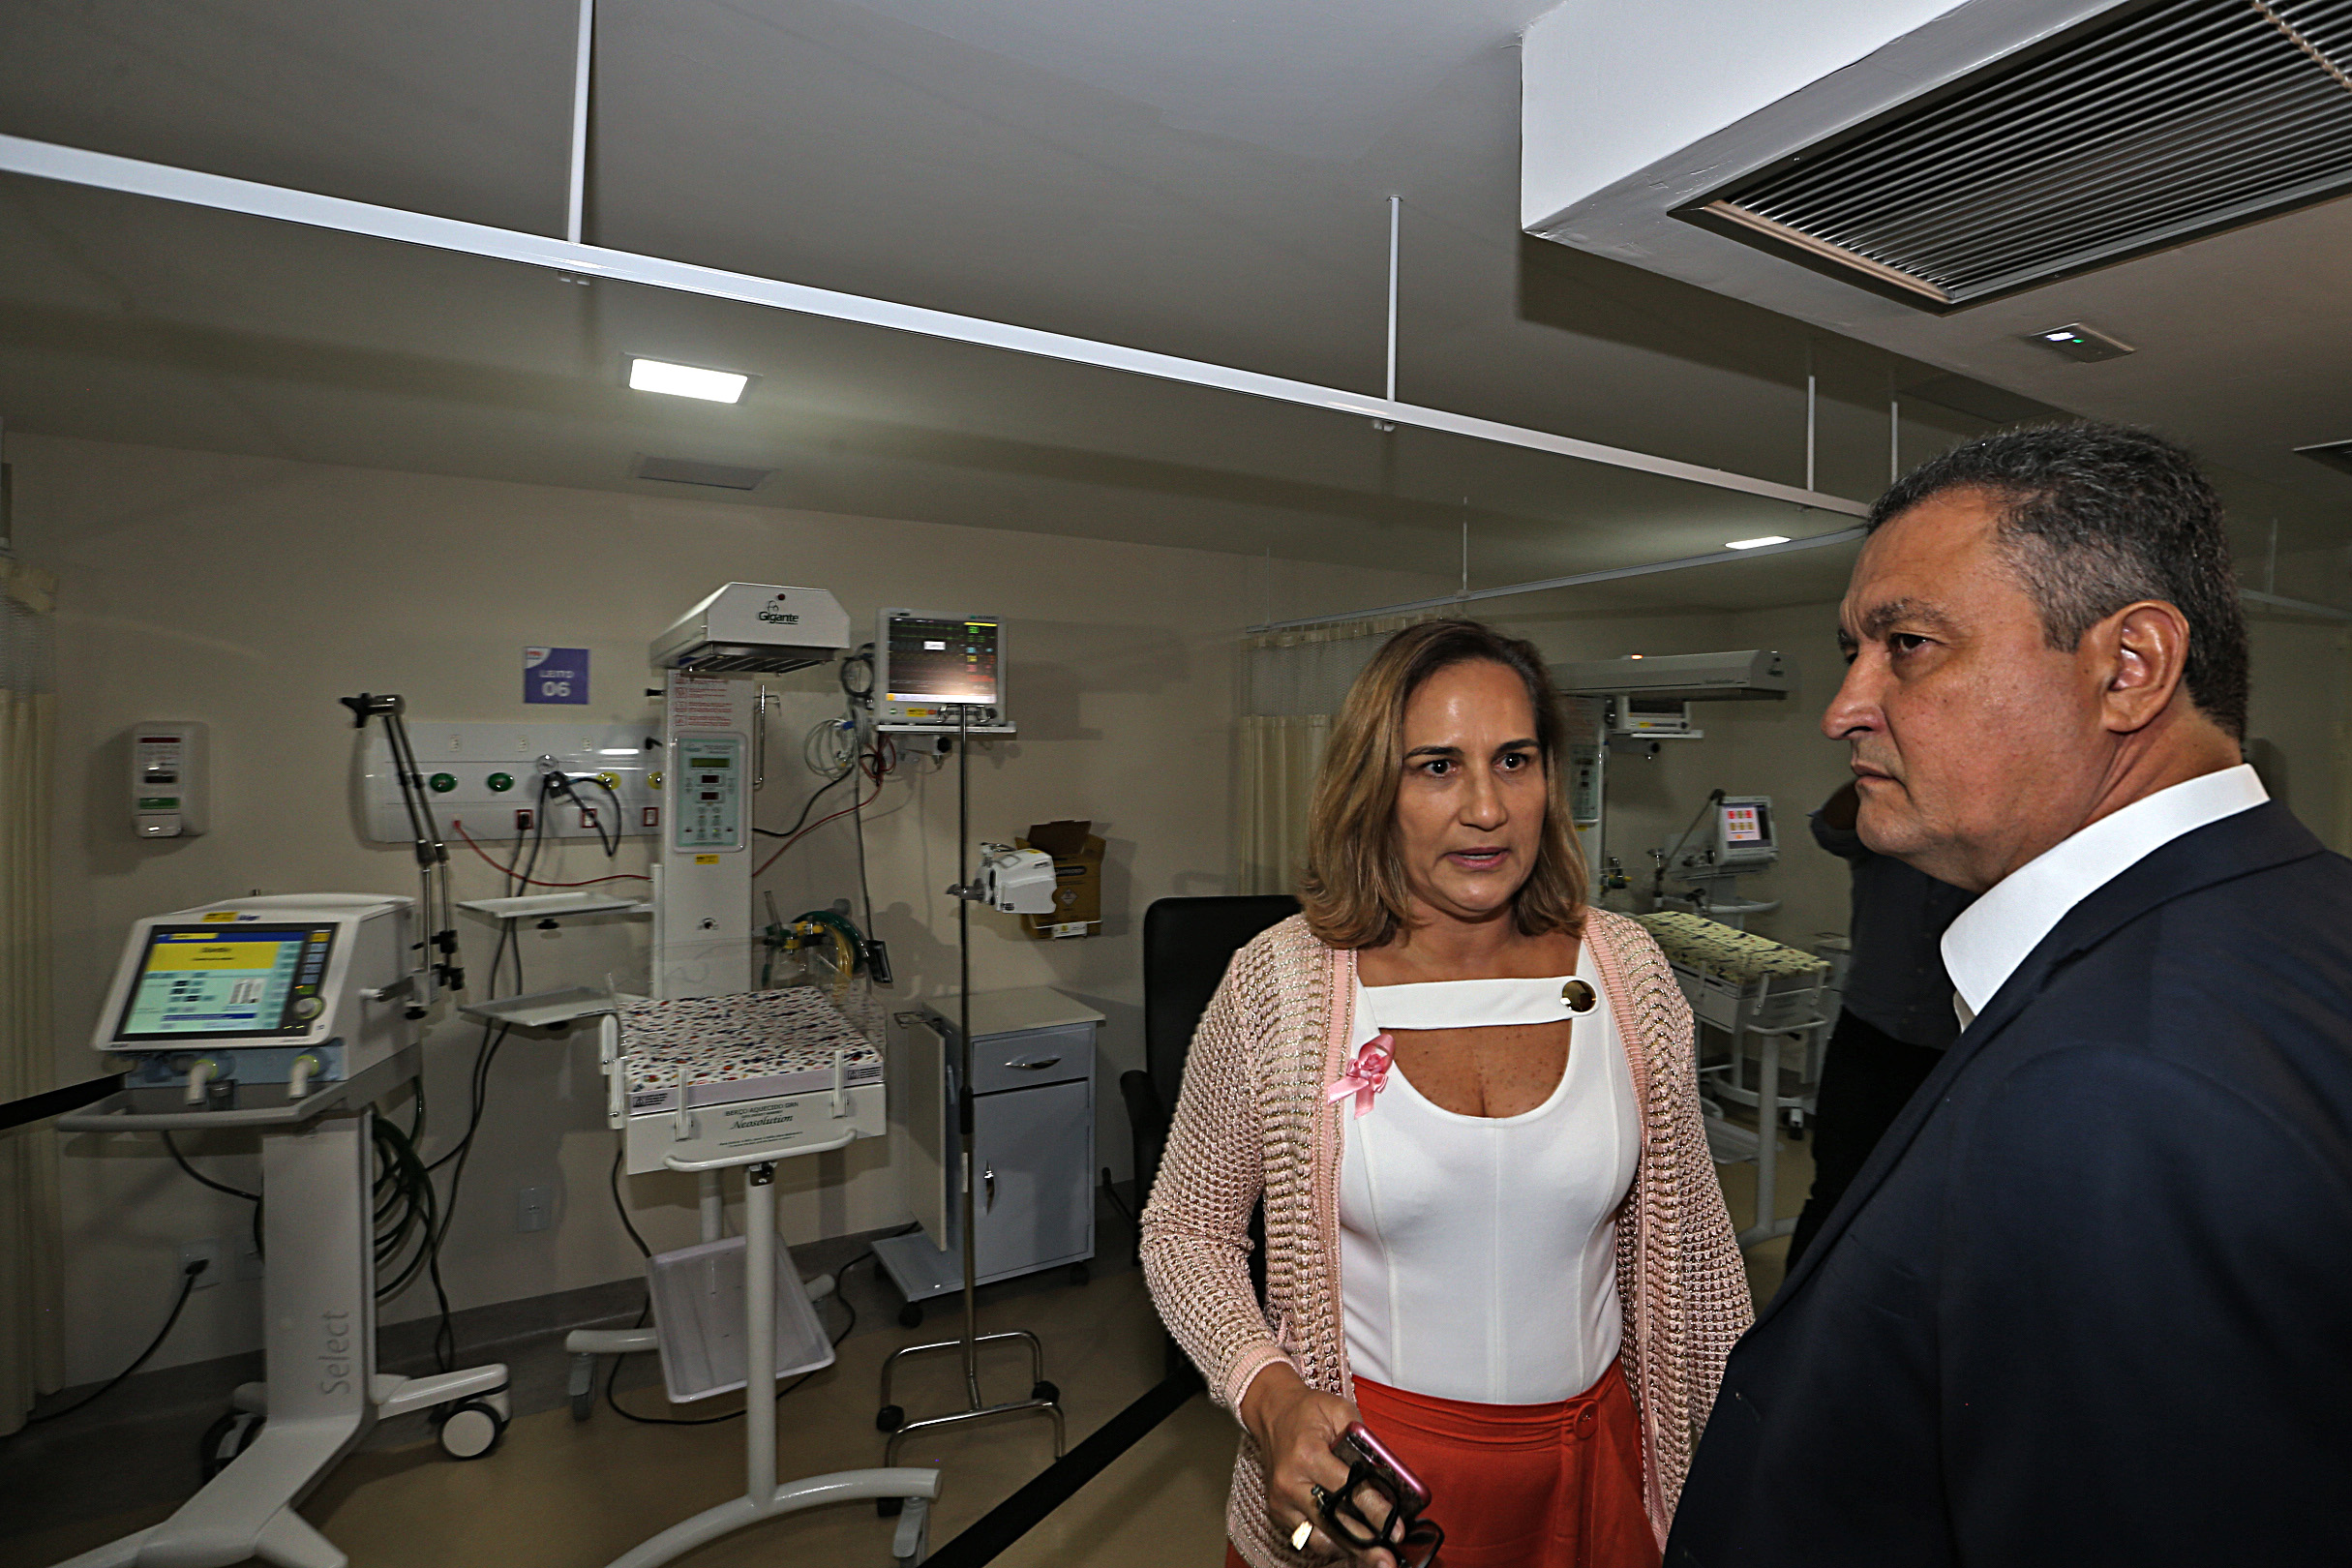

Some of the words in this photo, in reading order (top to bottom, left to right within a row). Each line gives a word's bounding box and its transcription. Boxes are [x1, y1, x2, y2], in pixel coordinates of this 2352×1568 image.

[759, 611, 799, 624] Gigante
[542, 680, 571, 697] 06
[749, 1103, 784, 1113] AQUECIDO
[729, 1115, 794, 1130] Neosolution
[317, 1310, 350, 1395] Select
